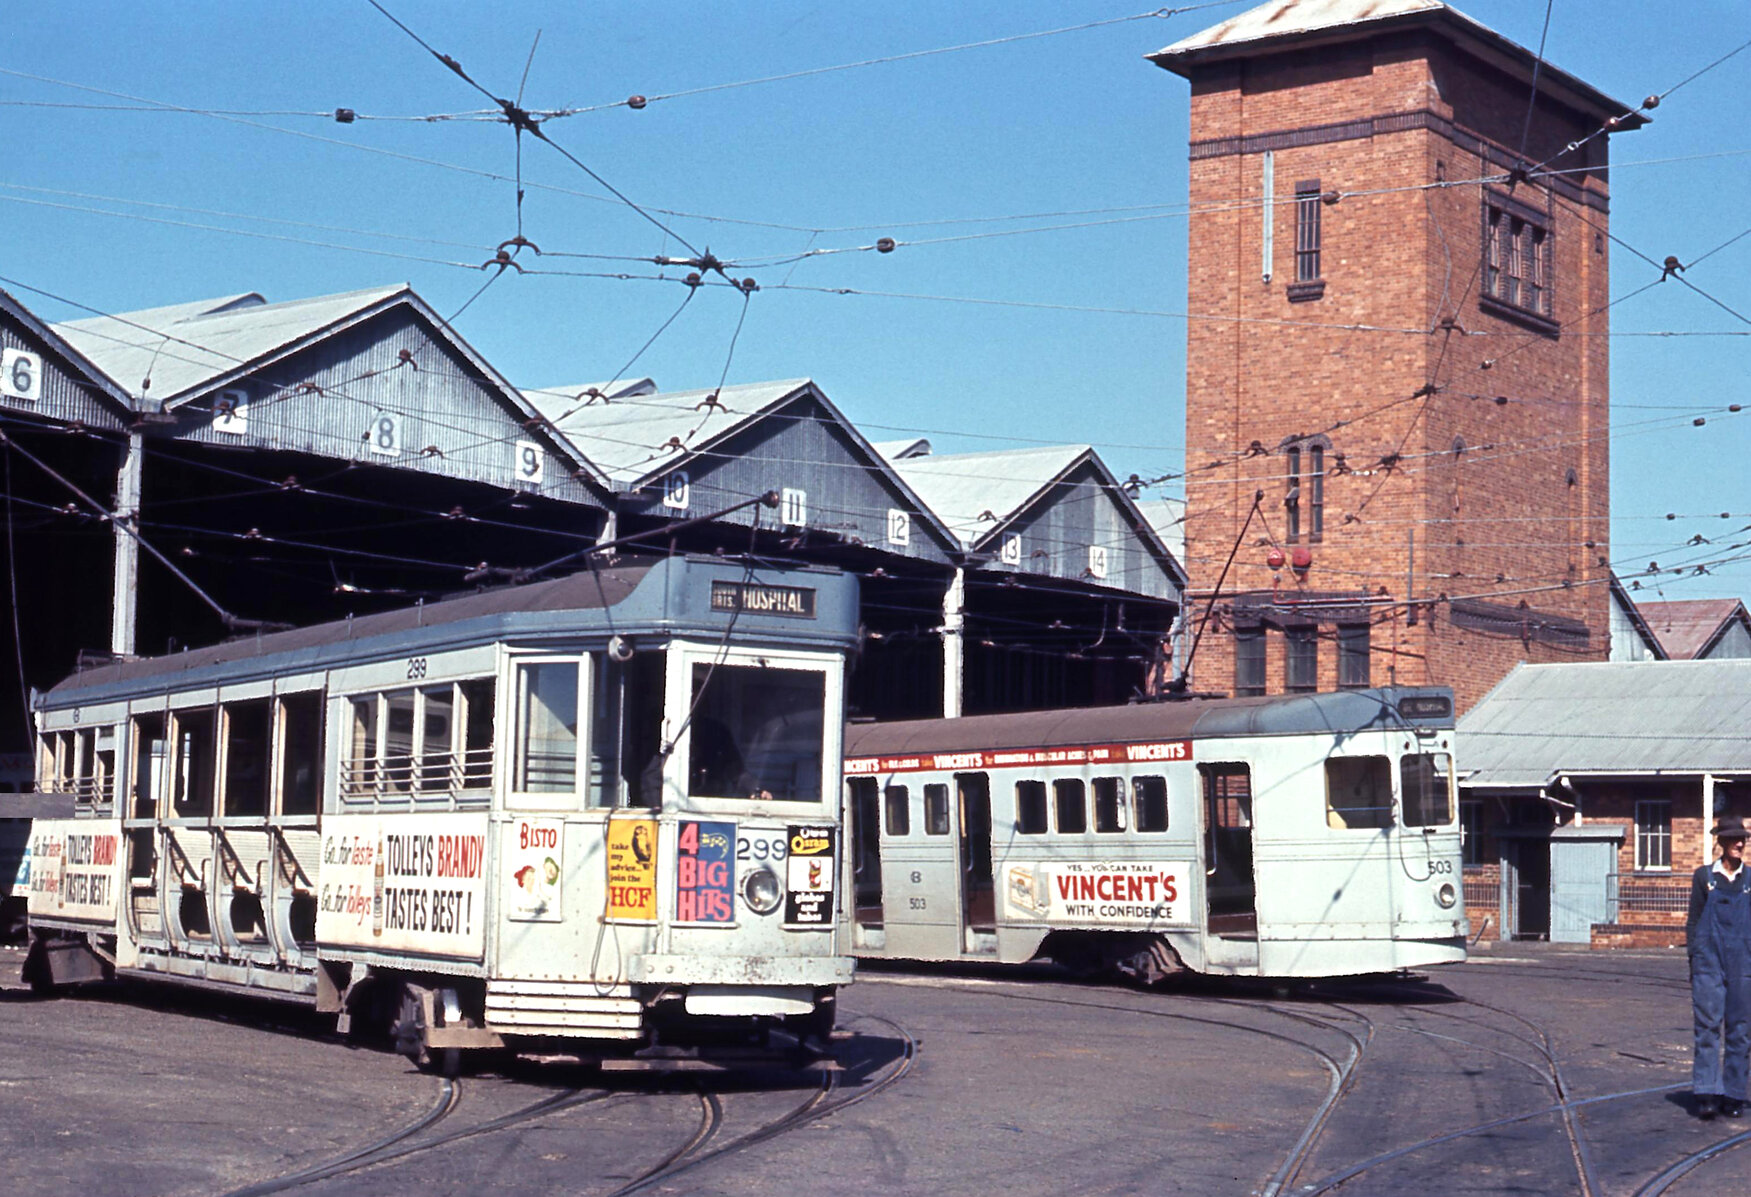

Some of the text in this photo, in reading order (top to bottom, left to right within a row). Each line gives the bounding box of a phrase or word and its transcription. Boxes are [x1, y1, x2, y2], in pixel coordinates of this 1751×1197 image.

[12, 356, 32, 392] 6
[221, 392, 240, 424] 7
[378, 417, 394, 449] 8
[522, 447, 539, 477] 9
[667, 472, 684, 503] 10
[789, 493, 800, 522] 11
[891, 513, 905, 540] 12
[1005, 535, 1018, 559] 13
[1094, 549, 1104, 572] 14
[407, 658, 427, 679] 299
[679, 823, 698, 855] 4
[738, 838, 786, 861] 299
[387, 835, 485, 879] TOLLEYS BRANDY
[611, 854, 623, 862] my
[1110, 864, 1128, 872] CAN
[1130, 864, 1153, 872] TAKE
[1427, 860, 1452, 875] 503
[609, 874, 626, 882] join
[679, 857, 730, 888] BIG
[610, 886, 652, 908] HCF
[1057, 872, 1178, 902] VINCENT'S
[385, 887, 428, 931] TASTES
[678, 889, 731, 921] HITS
[909, 897, 926, 910] 503
[1066, 904, 1173, 919] WITH CONFIDENCE
